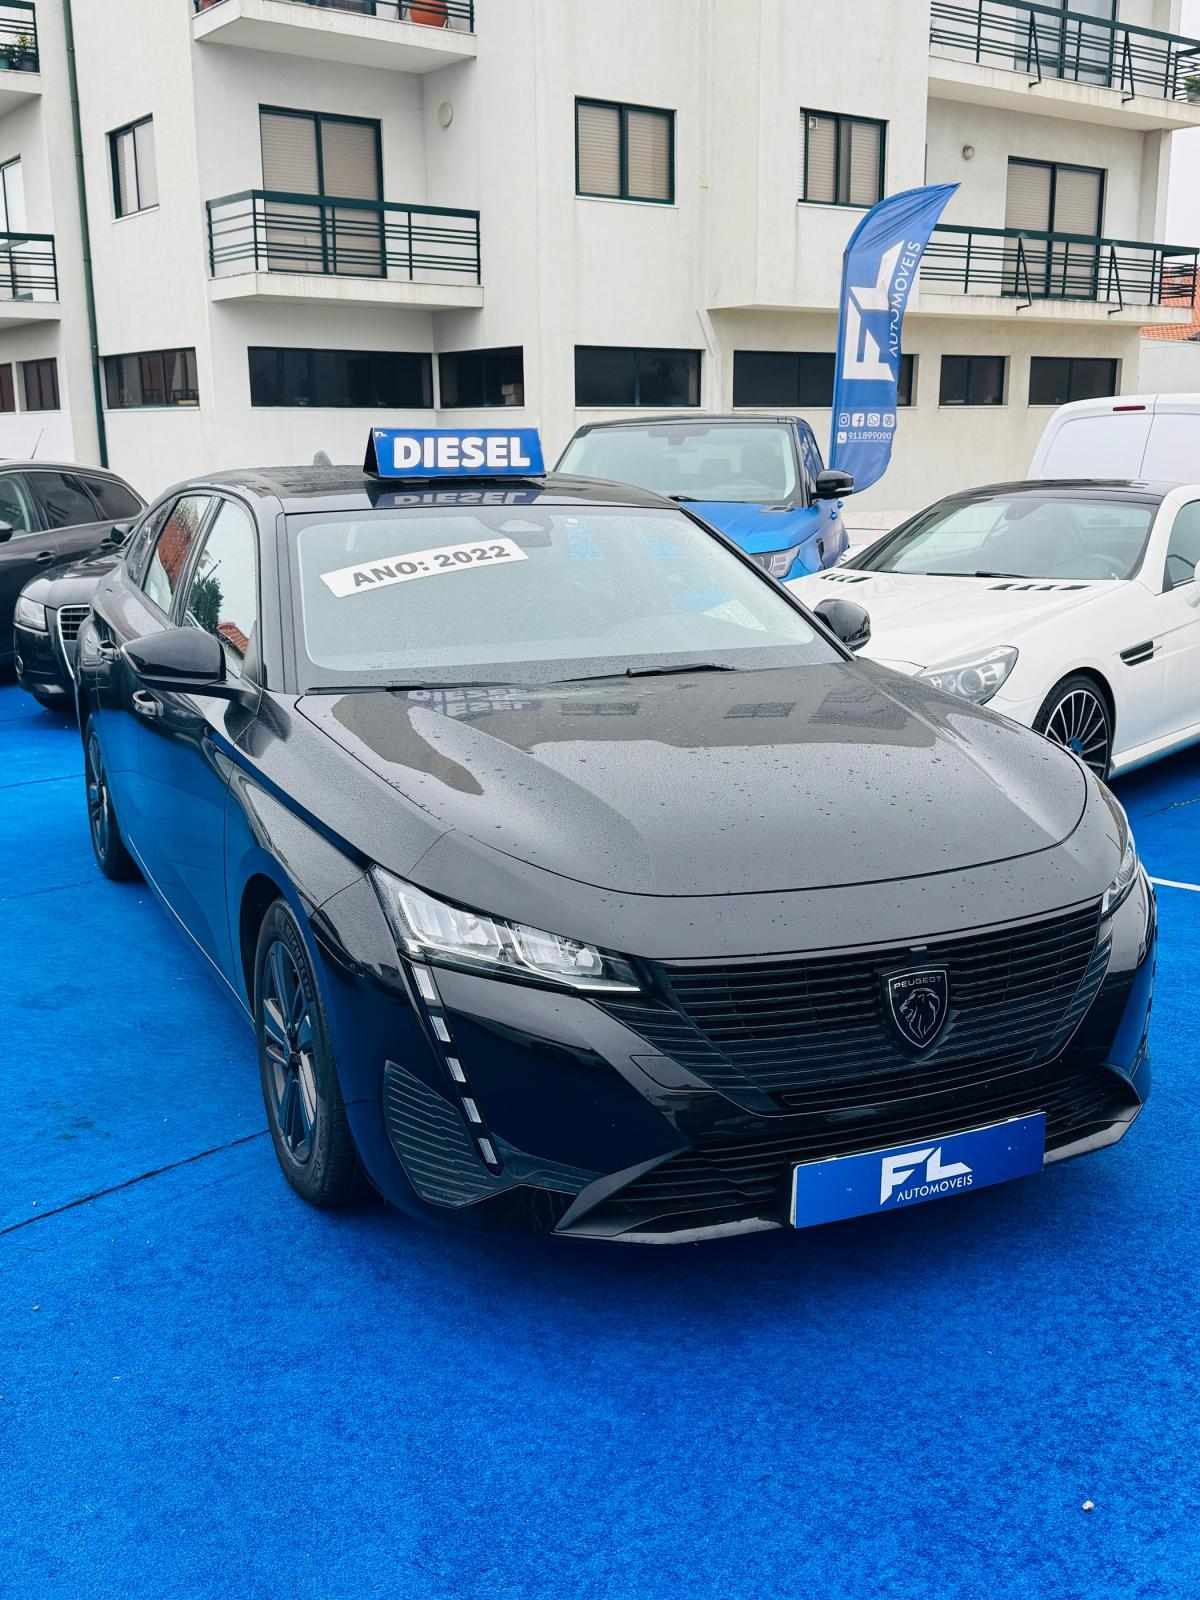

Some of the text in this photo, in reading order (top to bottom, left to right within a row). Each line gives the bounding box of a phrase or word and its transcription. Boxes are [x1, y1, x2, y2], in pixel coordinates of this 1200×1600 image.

[842, 240, 905, 382] FL
[888, 240, 921, 358] AUTOMOVEIS
[393, 437, 531, 468] DIESEL
[352, 545, 511, 587] ANO: 2022
[893, 975, 942, 990] PEUGEOT
[880, 1146, 974, 1206] FL
[896, 1174, 973, 1203] AUTOMOVEIS
